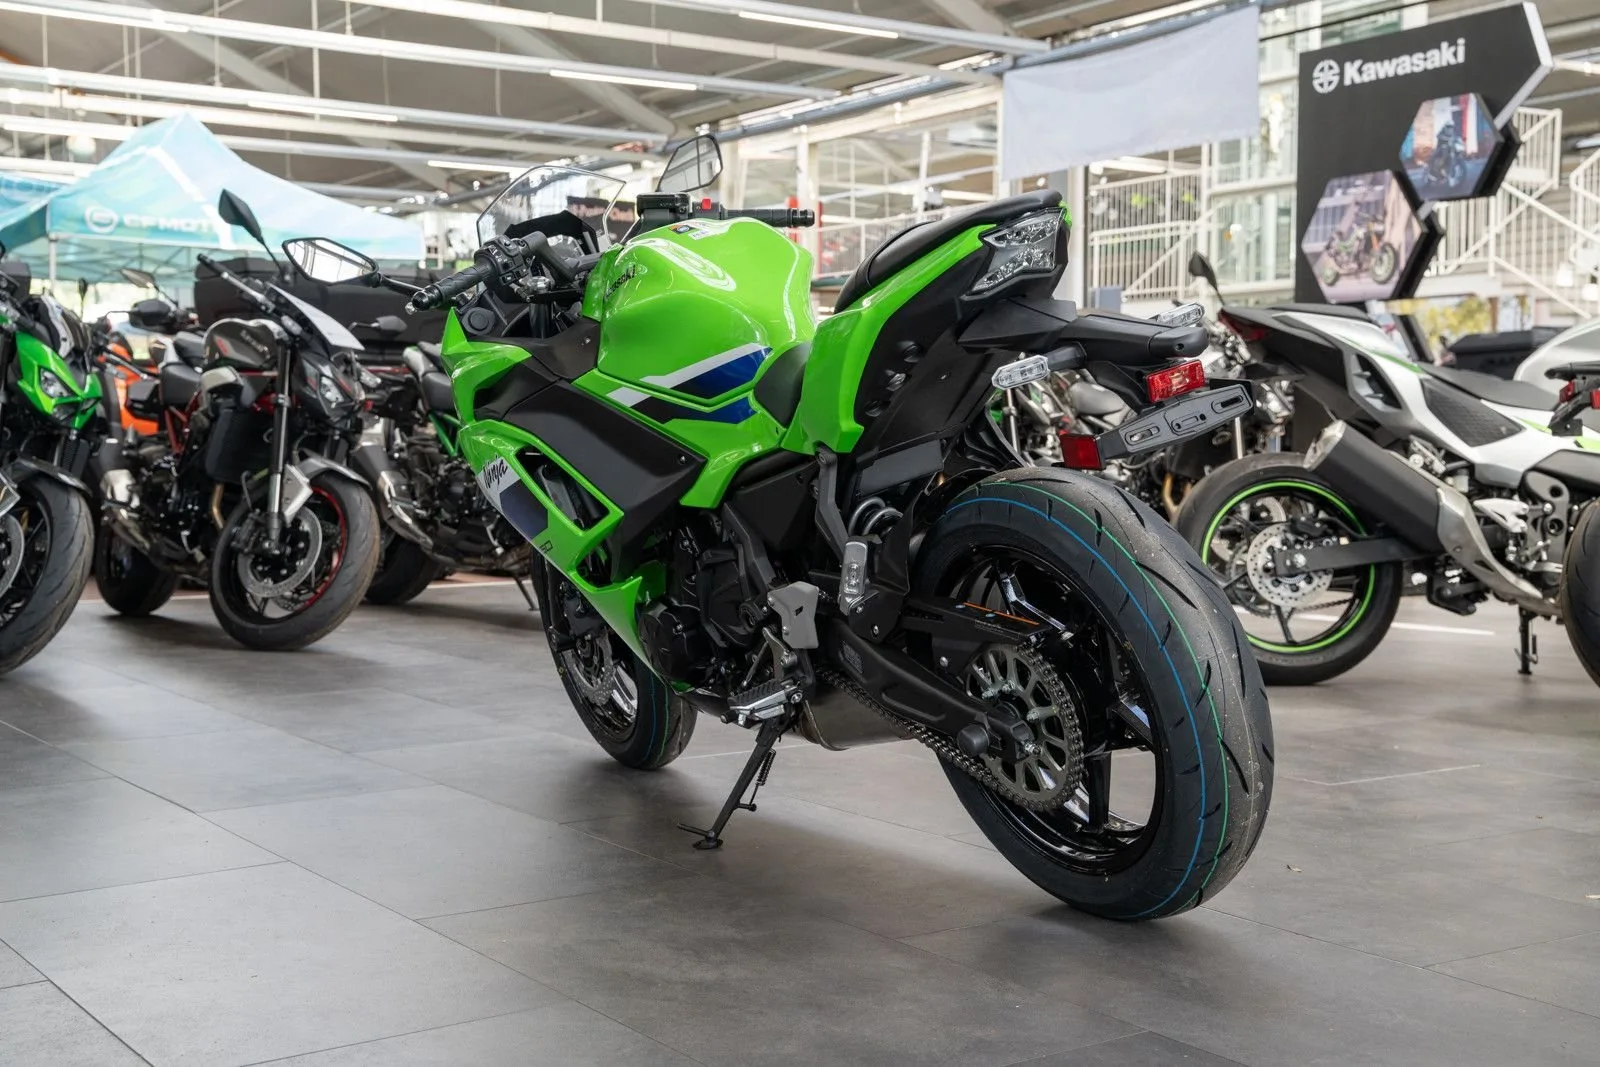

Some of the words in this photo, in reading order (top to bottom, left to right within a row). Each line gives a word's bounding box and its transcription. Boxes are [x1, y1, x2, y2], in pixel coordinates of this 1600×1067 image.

[1343, 37, 1466, 86] Kawasaki
[123, 213, 217, 233] CFMOT
[482, 453, 508, 489] Ninja
